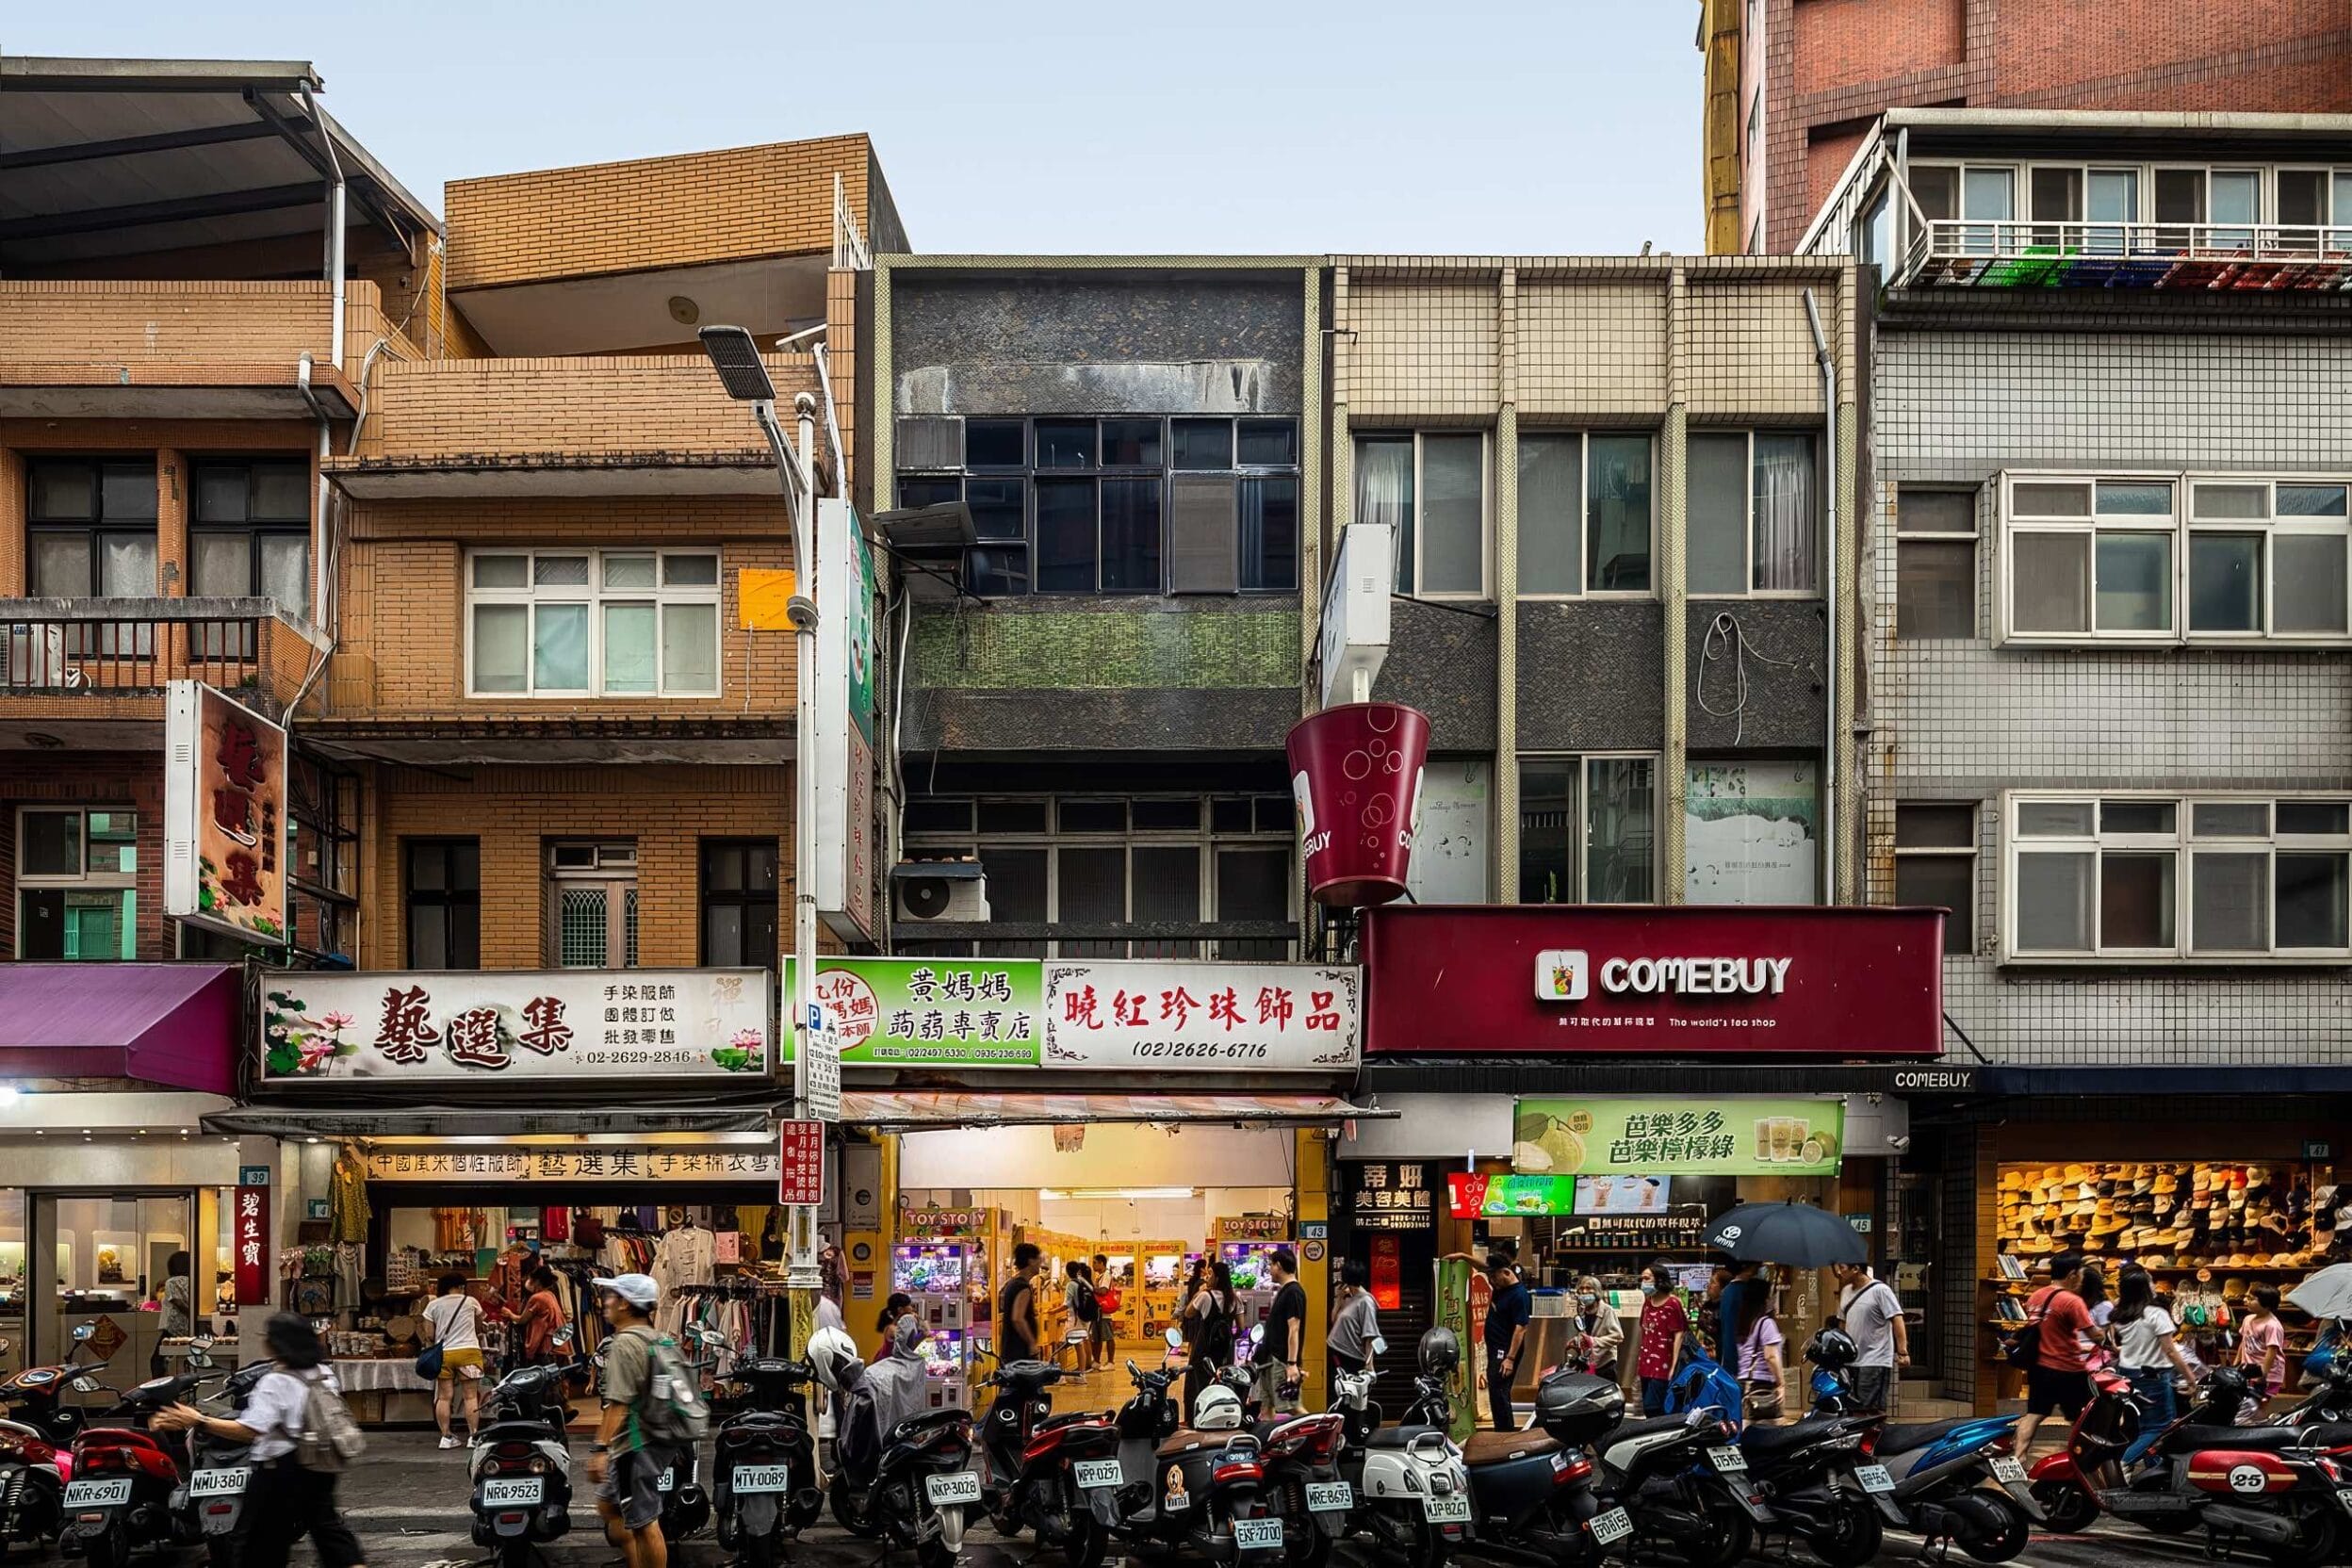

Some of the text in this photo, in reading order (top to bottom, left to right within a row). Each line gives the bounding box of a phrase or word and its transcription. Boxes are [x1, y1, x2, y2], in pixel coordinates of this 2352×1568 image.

[1601, 956, 1792, 995] COMEBUY
[604, 985, 676, 1001] 手染服飾
[909, 970, 1011, 1003] 黃媽媽
[604, 1007, 676, 1022] 團體訂做
[1064, 984, 1341, 1033] 曉紅珍珠飾品
[374, 986, 573, 1068] 藝選集
[889, 1009, 1031, 1041] 蒟蒻專賣店
[1670, 1018, 1687, 1027] The
[1752, 1018, 1776, 1028] shop
[604, 1028, 676, 1044] 批發零售
[1133, 1040, 1267, 1058] (02)2626-6716
[1895, 1072, 1970, 1087] COMEBUY
[1625, 1112, 1723, 1138] 芭樂多多
[1609, 1135, 1734, 1164] 芭樂檸檬綠
[538, 1149, 639, 1176] 藝選集
[251, 1172, 265, 1184] 39
[908, 1213, 987, 1225] TOY STOY
[1855, 1220, 1868, 1231] 45
[1311, 1227, 1323, 1237] 43
[193, 1474, 249, 1491] NMU-380
[2233, 1474, 2262, 1487] 25
[66, 1485, 126, 1503] NKR-6901
